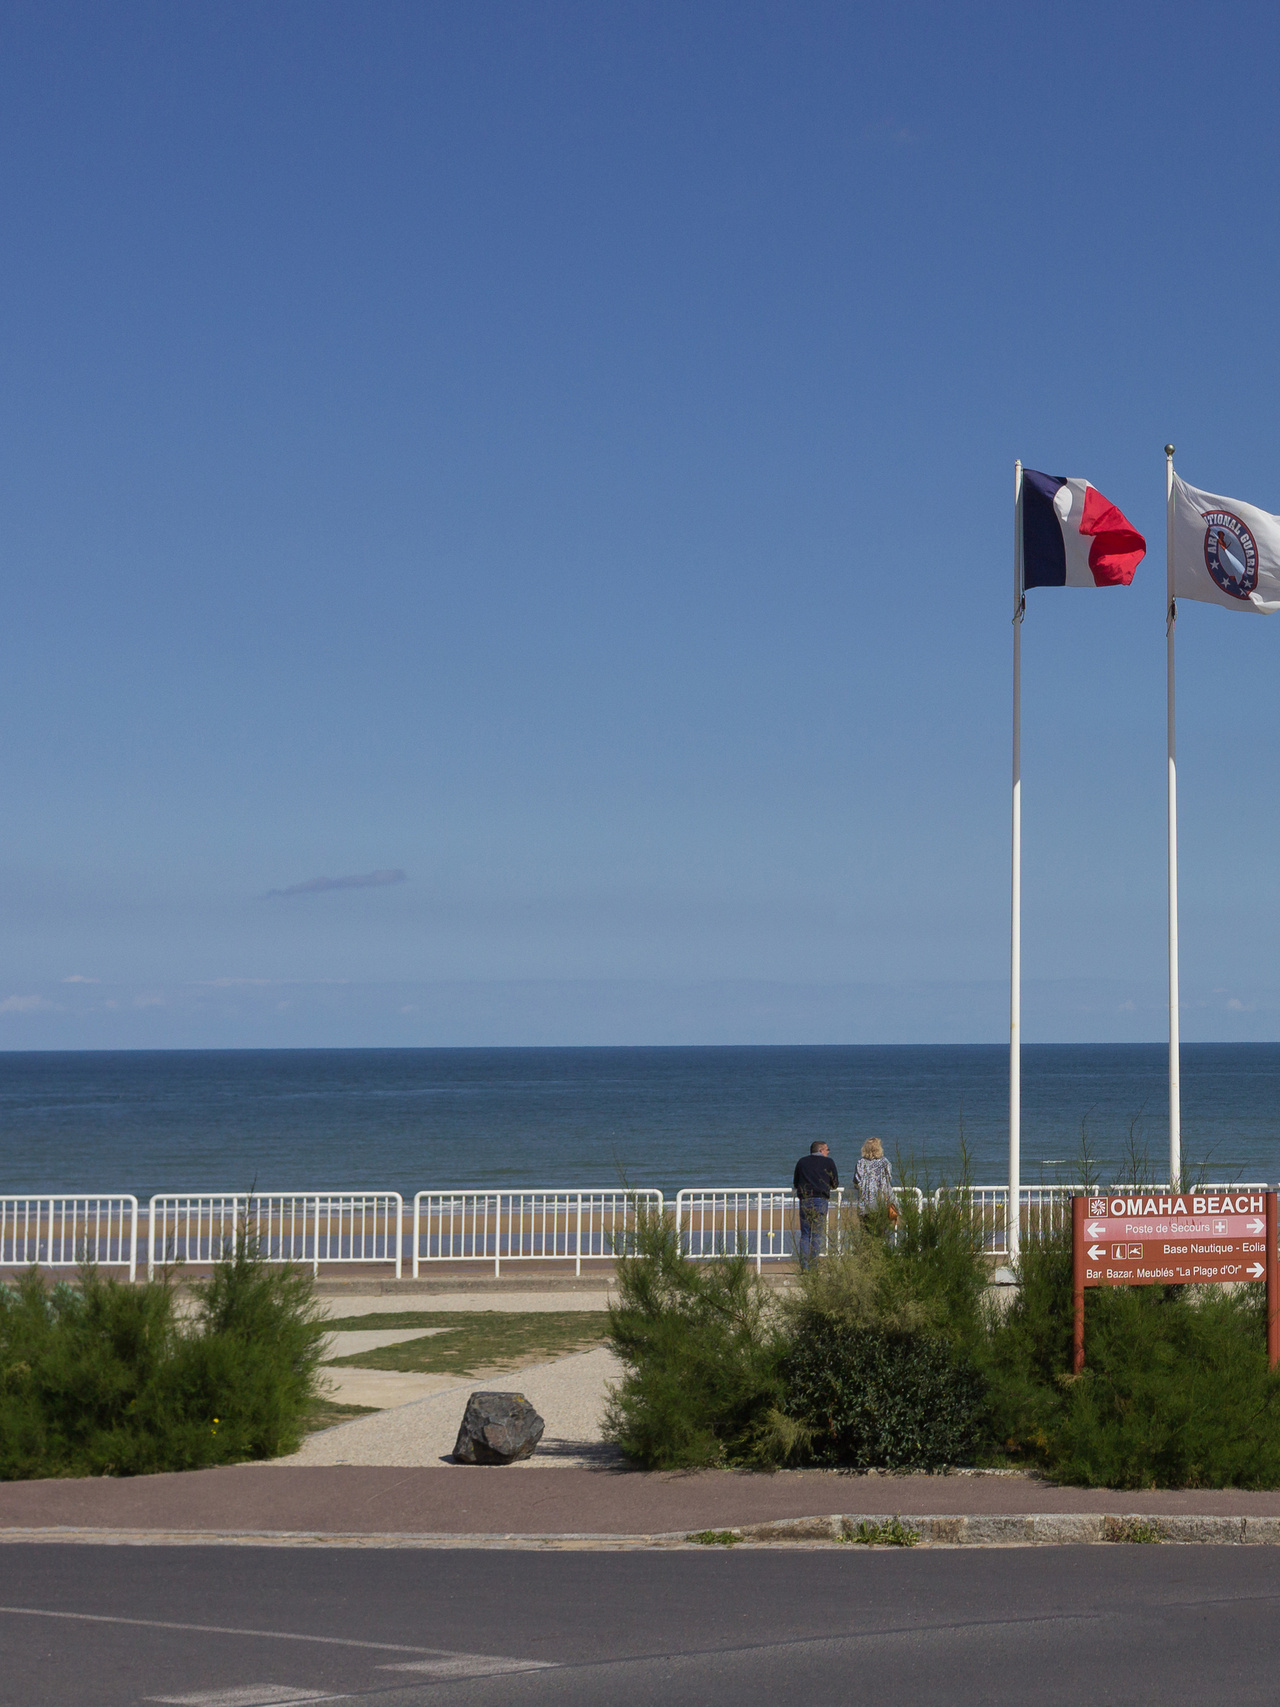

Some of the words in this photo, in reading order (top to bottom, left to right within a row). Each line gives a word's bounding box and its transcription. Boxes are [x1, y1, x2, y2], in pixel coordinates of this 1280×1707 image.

[1240, 534, 1256, 575] GUARD
[1110, 1198, 1187, 1216] OMAHA
[1193, 1196, 1263, 1214] BEACH
[1125, 1224, 1153, 1234] Poste
[1156, 1224, 1168, 1233] de
[1170, 1223, 1210, 1232] Secours
[1163, 1244, 1187, 1254] Base
[1191, 1244, 1233, 1255] Nautique
[1243, 1243, 1266, 1252] Eolia
[1086, 1269, 1103, 1279] Bar.
[1107, 1269, 1134, 1278] Bazar.
[1137, 1268, 1174, 1277] Meublés
[1176, 1267, 1190, 1277] "La
[1193, 1266, 1218, 1276] Plage
[1220, 1265, 1242, 1274] d'Or"
